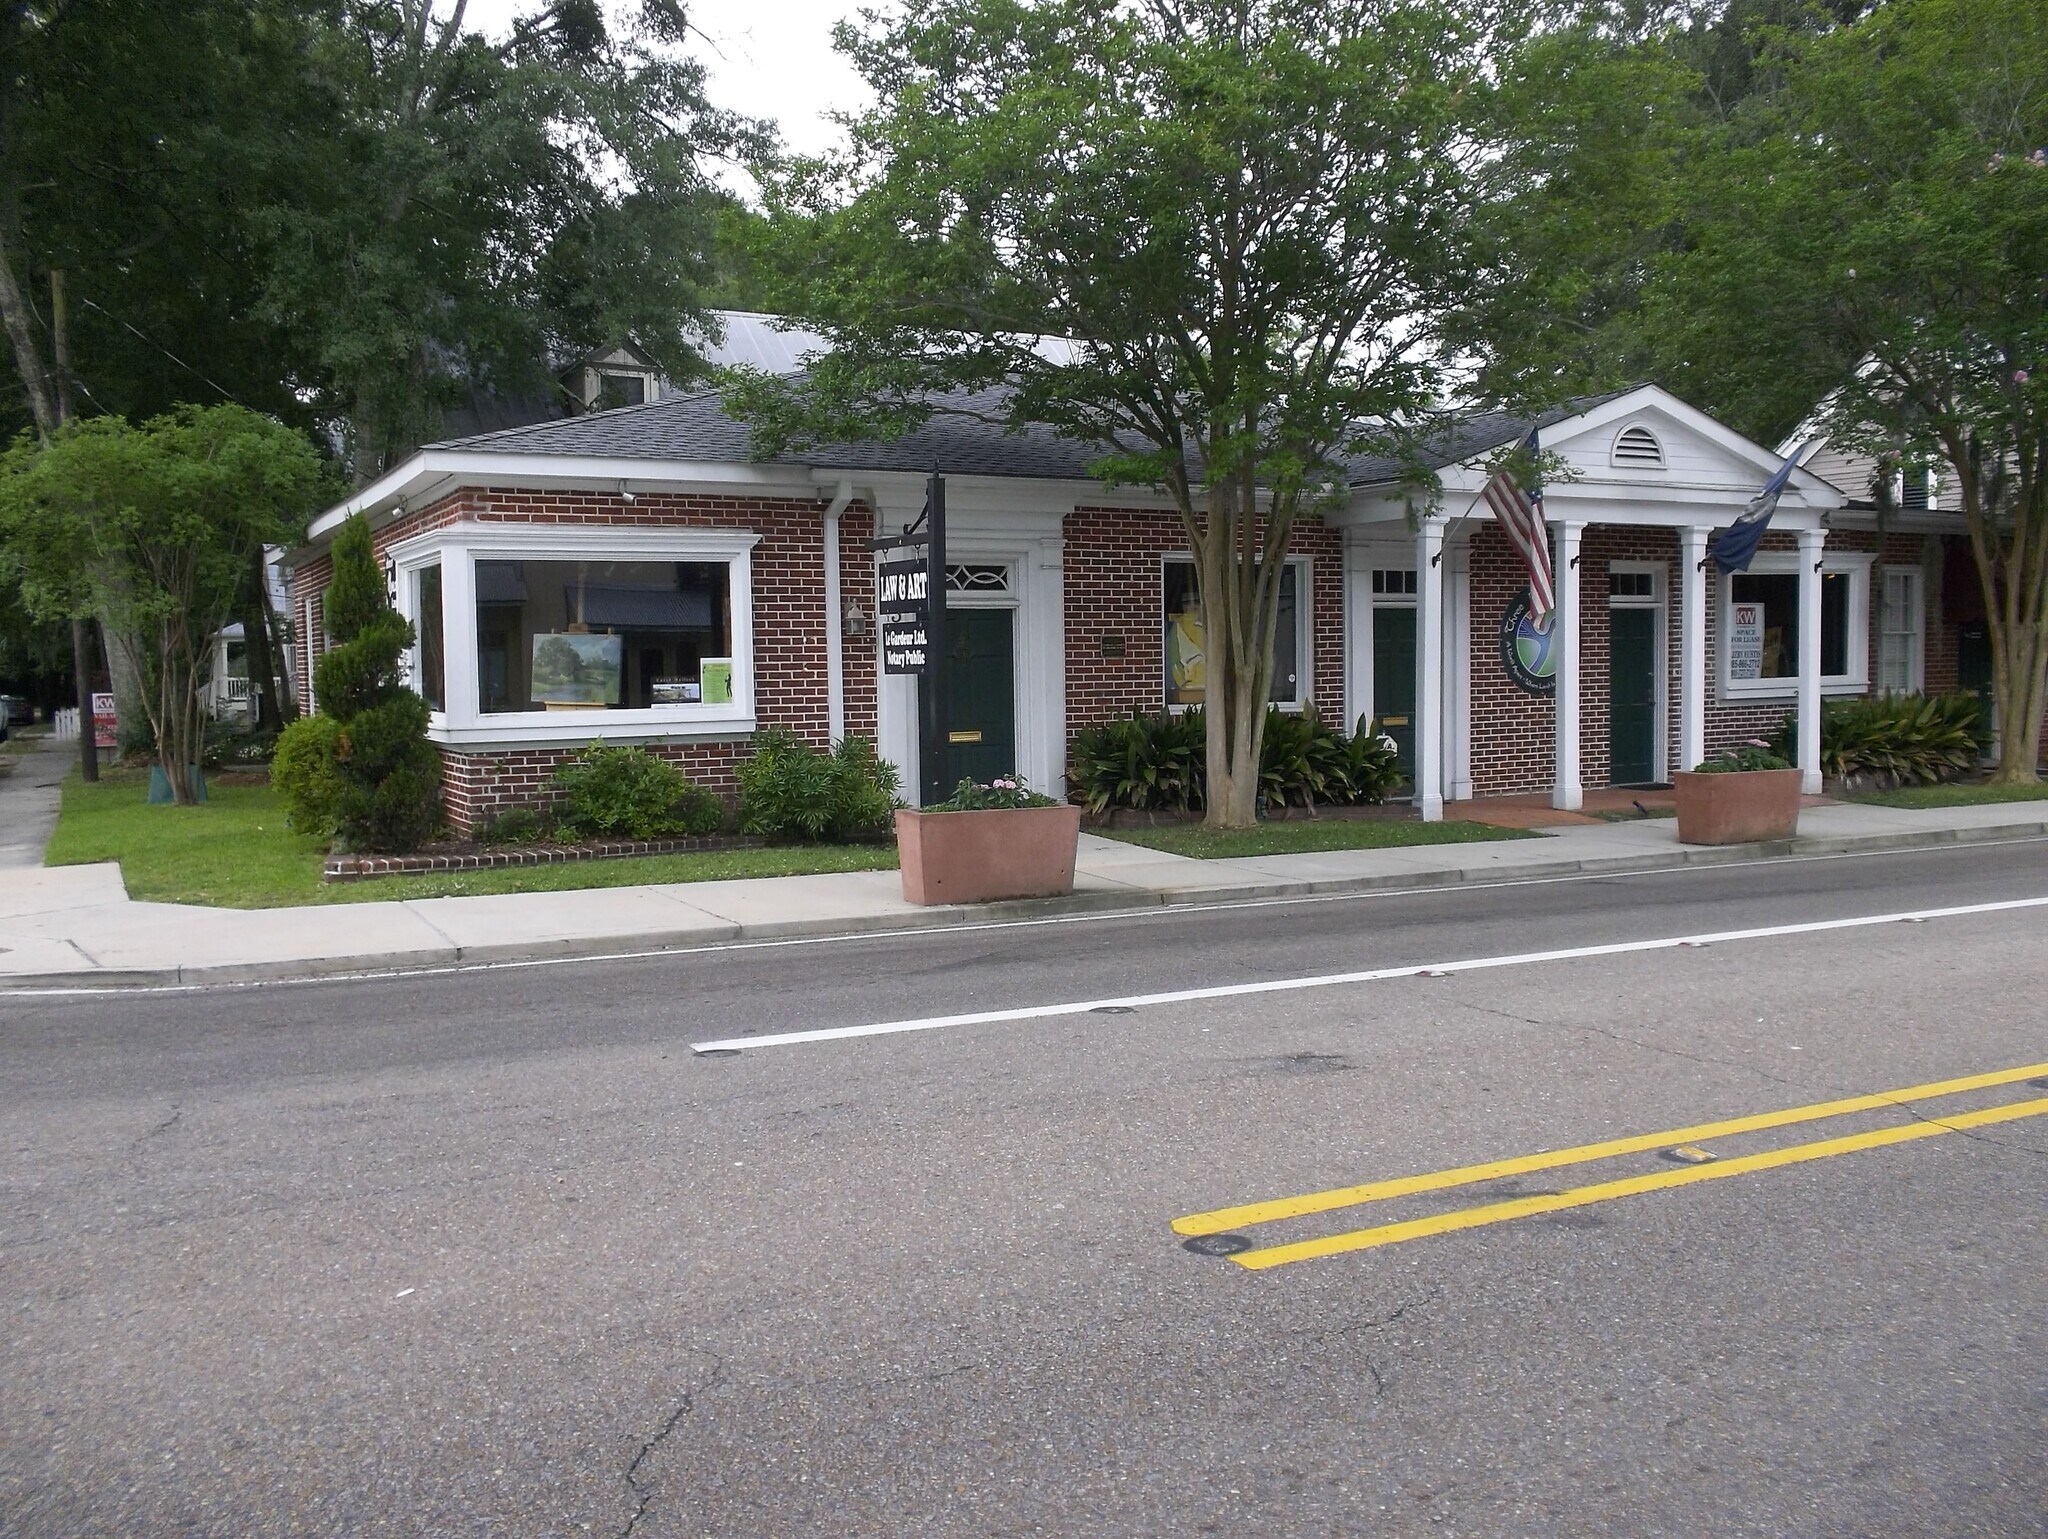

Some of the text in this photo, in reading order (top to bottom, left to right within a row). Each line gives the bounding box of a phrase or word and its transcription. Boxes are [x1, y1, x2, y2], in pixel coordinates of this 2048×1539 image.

[881, 572, 927, 602] LAW & ART
[1504, 604, 1524, 633] Three
[1737, 611, 1755, 623] KW
[890, 630, 914, 646] Gardeur
[914, 629, 928, 645] Ltd.
[887, 649, 926, 668] Notary Public
[96, 698, 114, 708] KW
